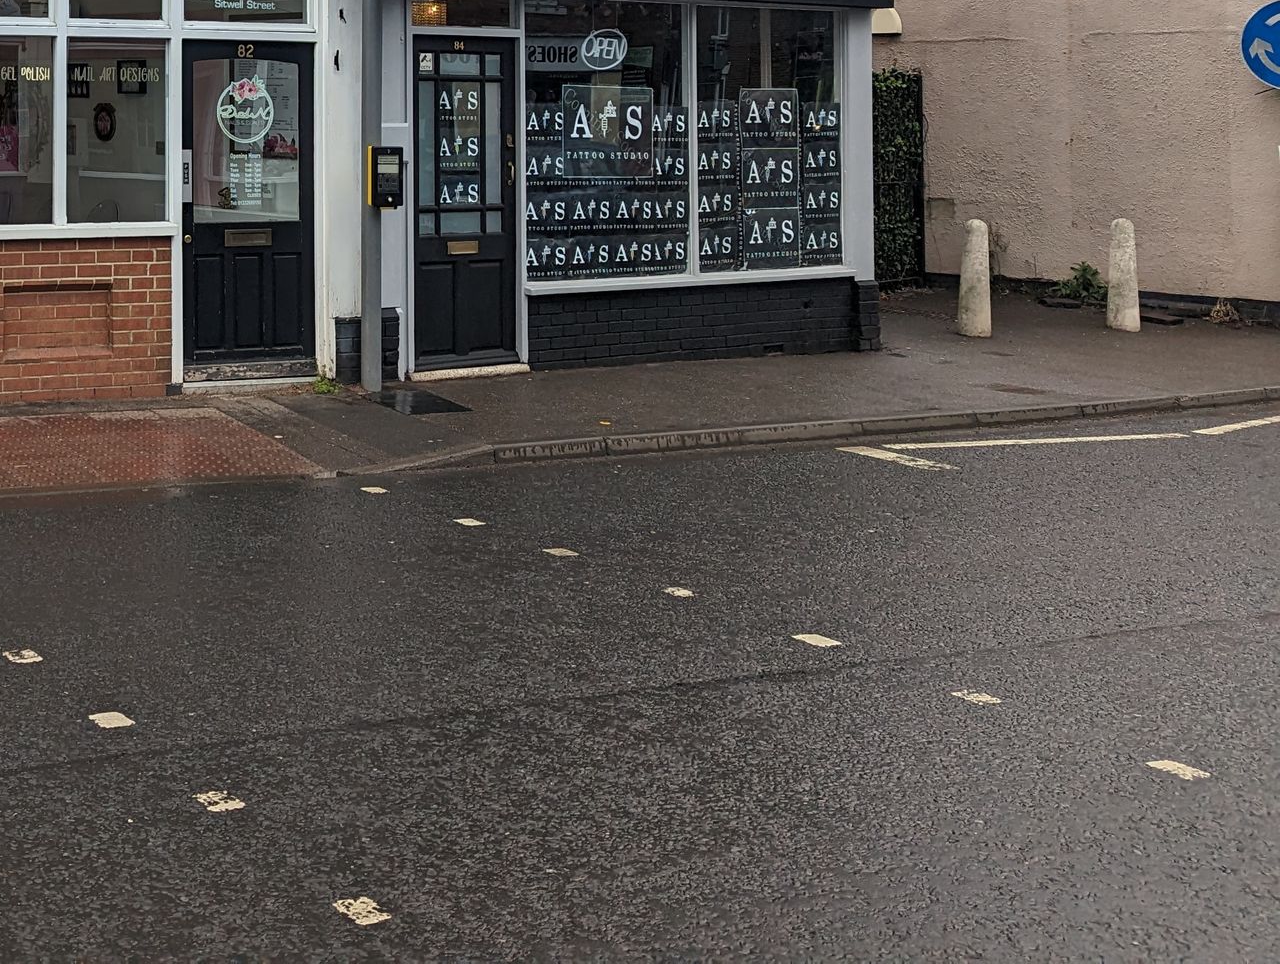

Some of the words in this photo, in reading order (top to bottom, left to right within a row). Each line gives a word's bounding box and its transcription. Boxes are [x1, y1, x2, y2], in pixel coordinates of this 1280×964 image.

[246, 0, 276, 10] Street
[237, 44, 254, 58] 82
[453, 41, 465, 51] 84
[584, 36, 625, 60] OPEN
[0, 65, 17, 81] GEL
[73, 66, 96, 82] NAIL
[99, 66, 117, 82] ART
[120, 67, 160, 82] DESIGNS
[440, 90, 452, 110] A
[468, 91, 478, 110] S
[527, 112, 540, 130] A
[554, 112, 564, 130] S
[698, 110, 710, 128] A
[722, 110, 730, 128] S
[745, 100, 762, 124] A
[780, 100, 792, 124] S
[806, 110, 818, 128] A
[827, 110, 836, 126] S
[570, 103, 594, 139] A
[625, 105, 643, 140] S
[652, 114, 662, 132] A
[676, 114, 685, 132] S
[440, 138, 452, 156] A
[468, 138, 478, 156] S
[610, 152, 649, 160] STUDIO
[526, 156, 539, 175] A
[555, 156, 564, 175] S
[674, 157, 684, 176] S
[698, 152, 709, 170] A
[722, 152, 731, 170] S
[806, 151, 816, 168] A
[829, 150, 836, 167] S
[746, 160, 762, 184] A
[781, 160, 794, 184] S
[440, 184, 452, 204] A
[468, 184, 478, 204] S
[698, 195, 711, 212] A
[723, 194, 732, 212] S
[806, 192, 818, 208] A
[830, 192, 838, 208] S
[526, 202, 538, 220] A
[554, 202, 566, 220] S
[573, 201, 586, 220] A
[600, 200, 610, 219] S
[616, 200, 630, 218] A
[643, 201, 652, 219] S
[676, 200, 685, 218] S
[749, 220, 764, 244] A
[782, 220, 794, 244] S
[806, 232, 818, 249] A
[830, 232, 838, 248] S
[572, 246, 585, 264] A
[598, 244, 608, 263] S
[615, 244, 628, 262] A
[641, 244, 652, 262] S
[676, 242, 684, 260] S
[700, 238, 712, 255] A
[722, 236, 732, 254] S
[526, 248, 539, 266] A
[555, 246, 566, 266] S
